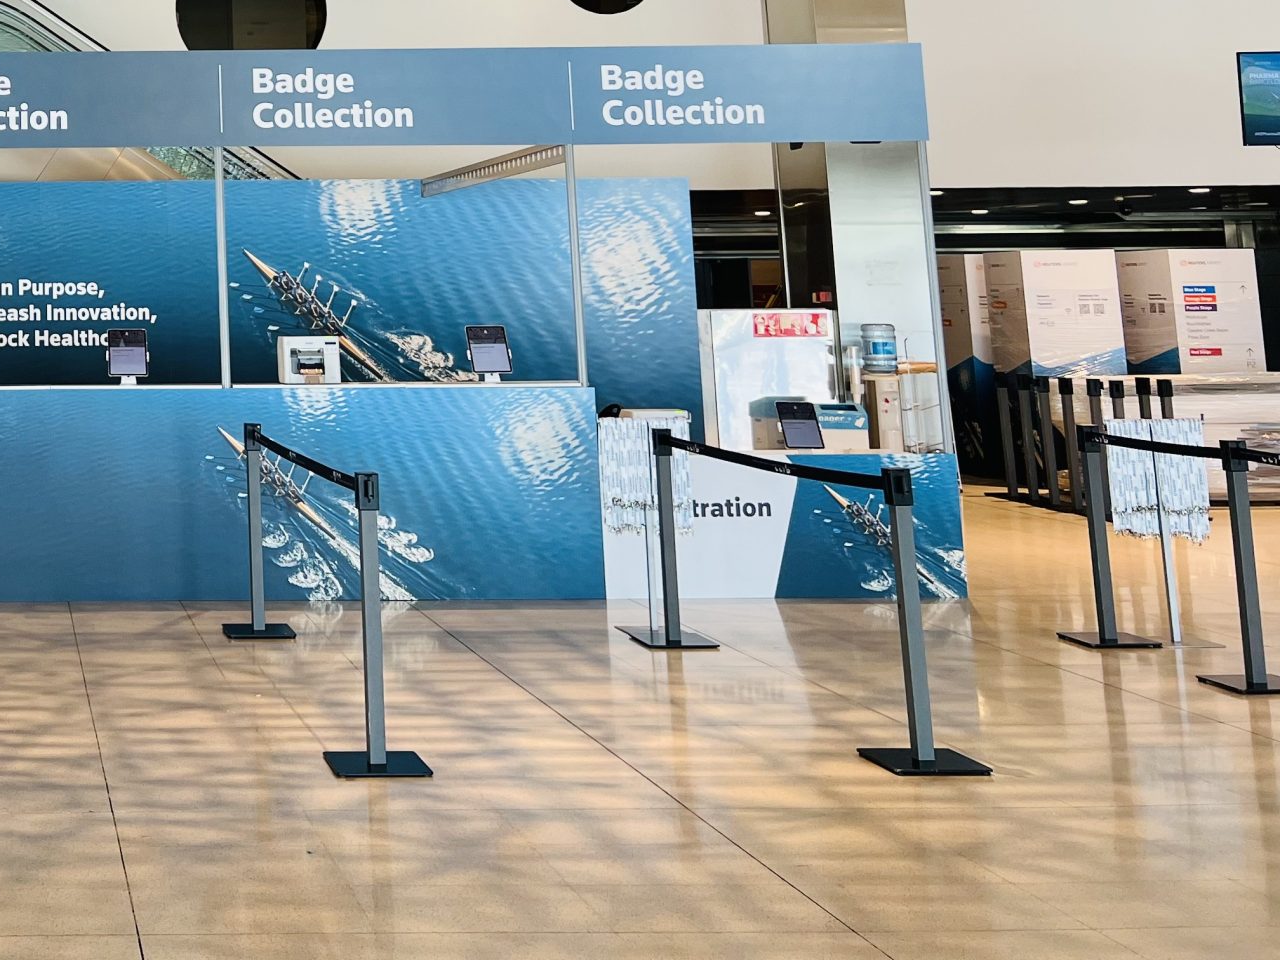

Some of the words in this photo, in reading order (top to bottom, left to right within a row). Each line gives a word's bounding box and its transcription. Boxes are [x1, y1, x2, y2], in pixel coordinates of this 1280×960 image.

[252, 67, 355, 100] Badge
[601, 64, 705, 97] Badge
[252, 102, 414, 129] Collection
[603, 98, 765, 126] Collection
[18, 278, 105, 300] Purpose,
[46, 302, 158, 325] Innovation,
[692, 496, 773, 518] tration
